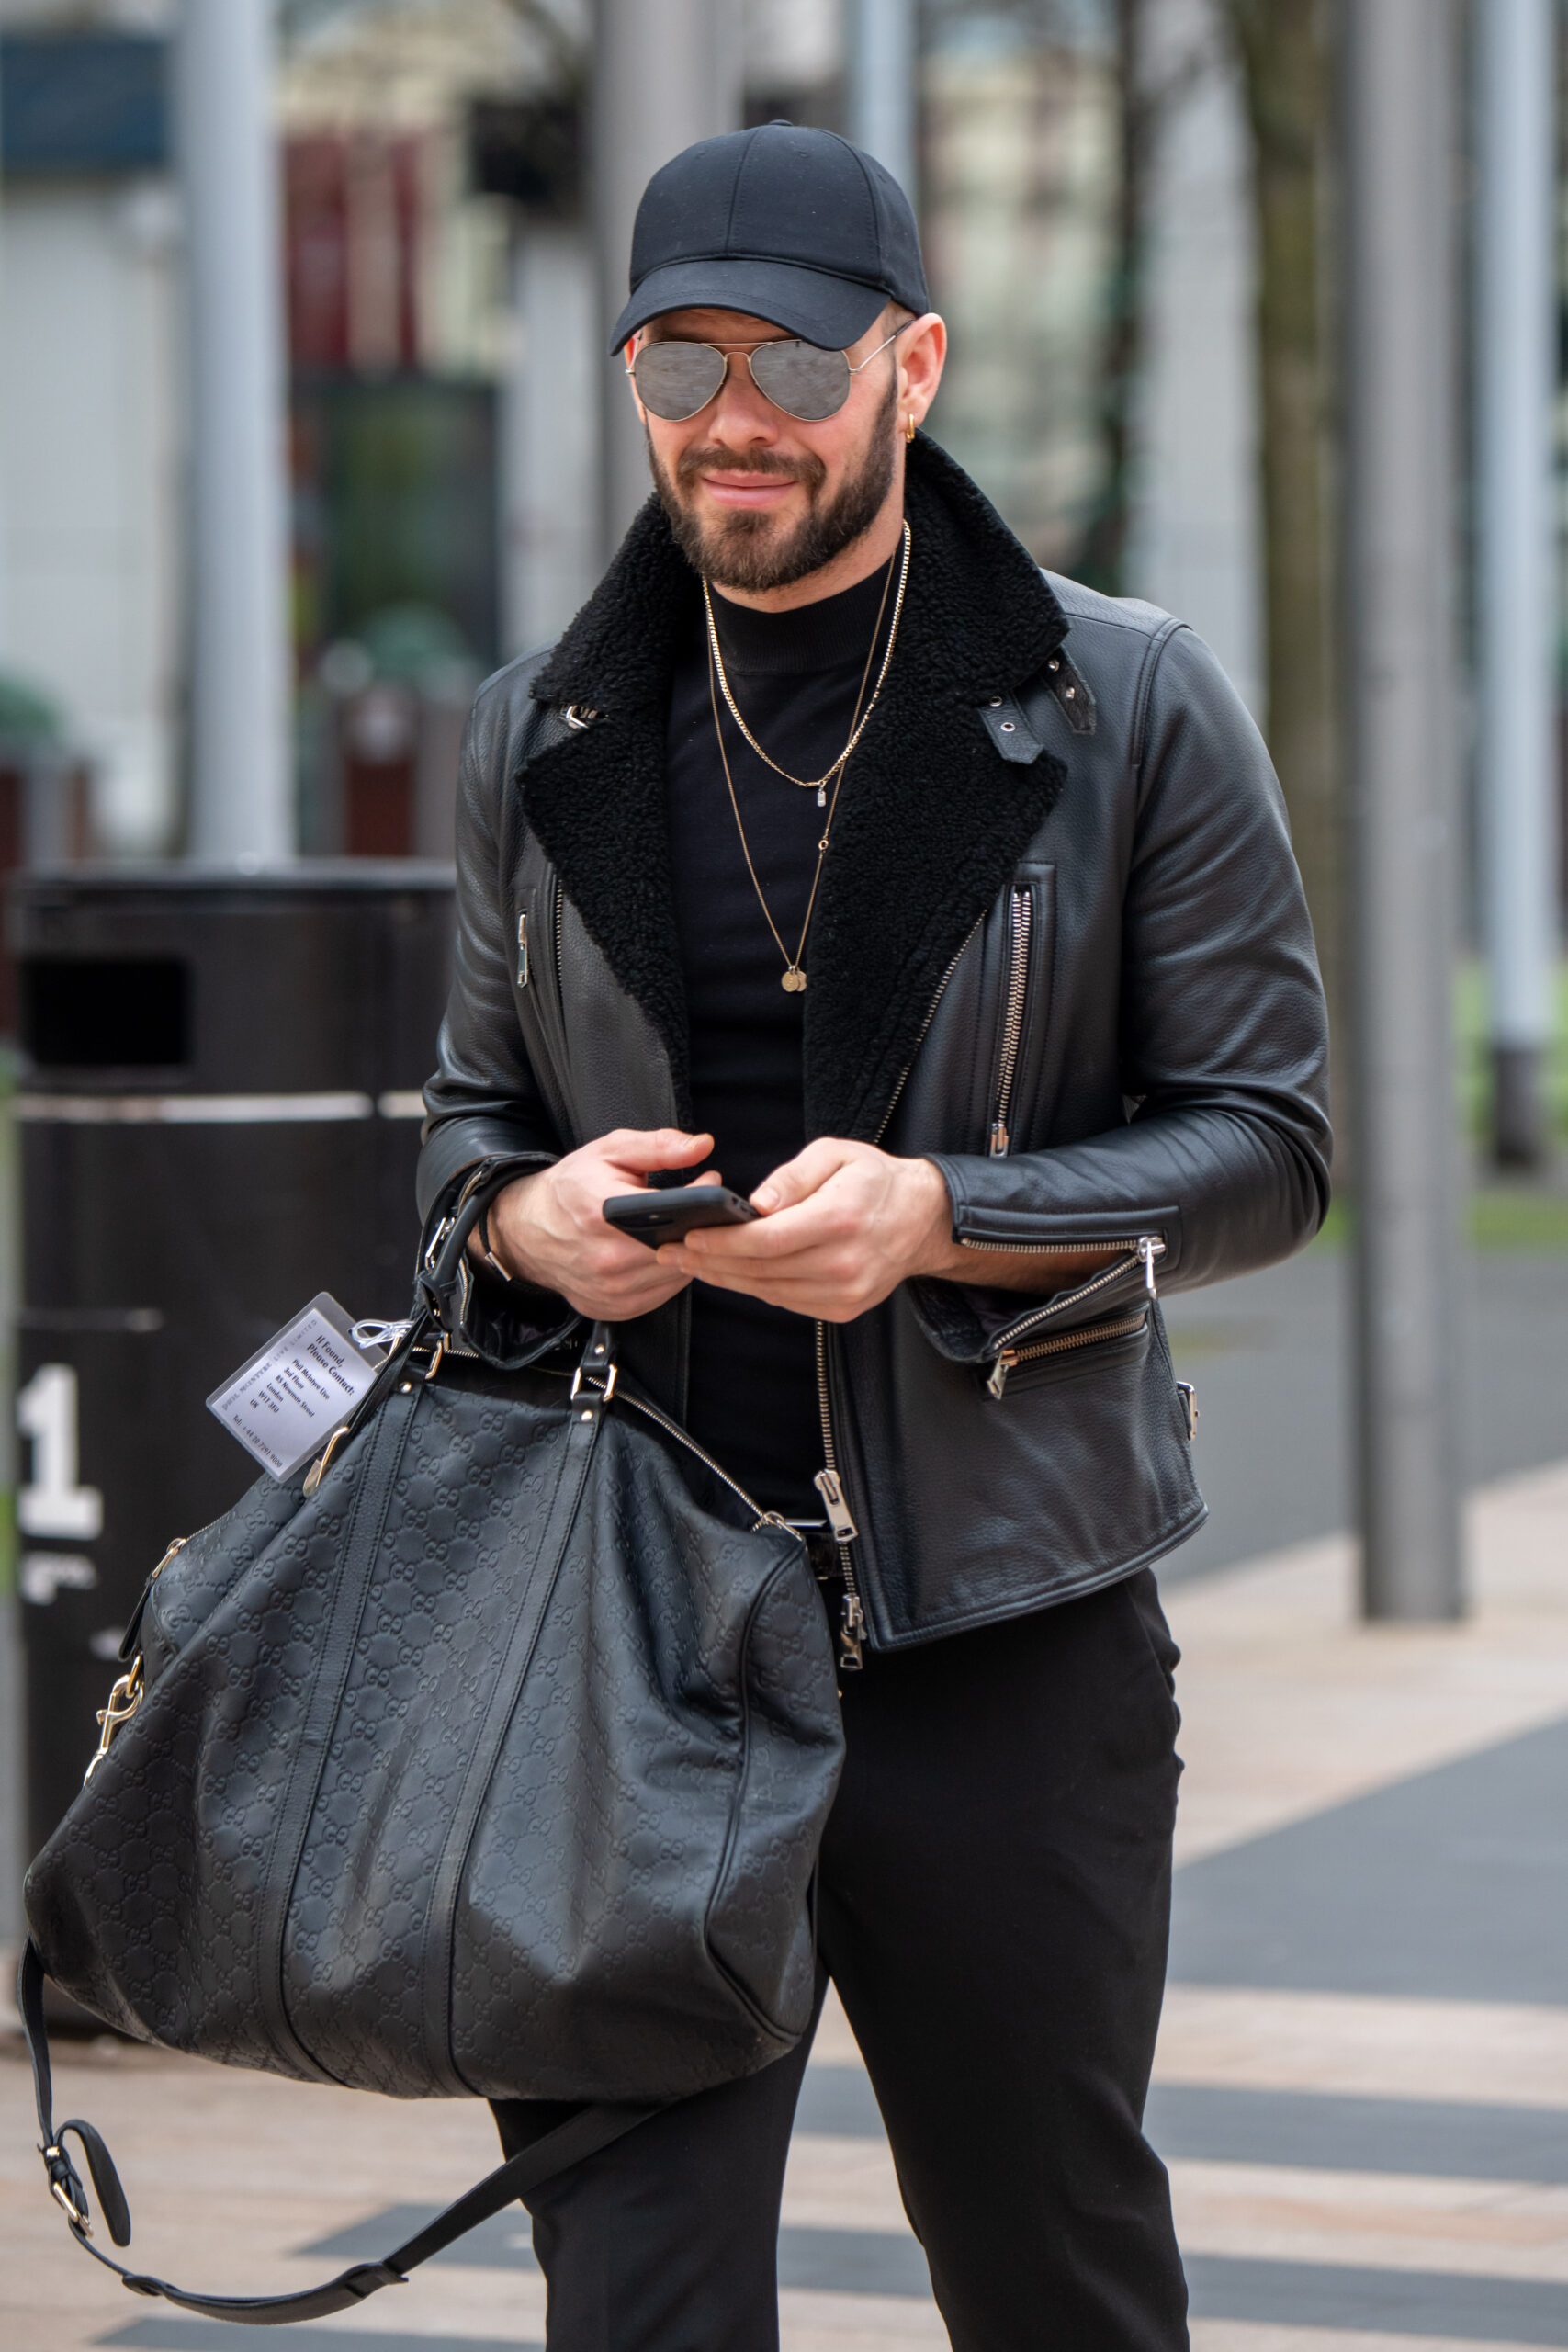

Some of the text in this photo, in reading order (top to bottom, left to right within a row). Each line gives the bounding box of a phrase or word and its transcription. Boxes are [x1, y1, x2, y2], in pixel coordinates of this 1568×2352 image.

[315, 1334, 347, 1368] If Found,
[291, 1357, 304, 1371] Phil
[318, 1386, 332, 1400] Live
[306, 1342, 356, 1396] Please Contact:
[248, 1397, 259, 1409] UK
[265, 1382, 285, 1402] London
